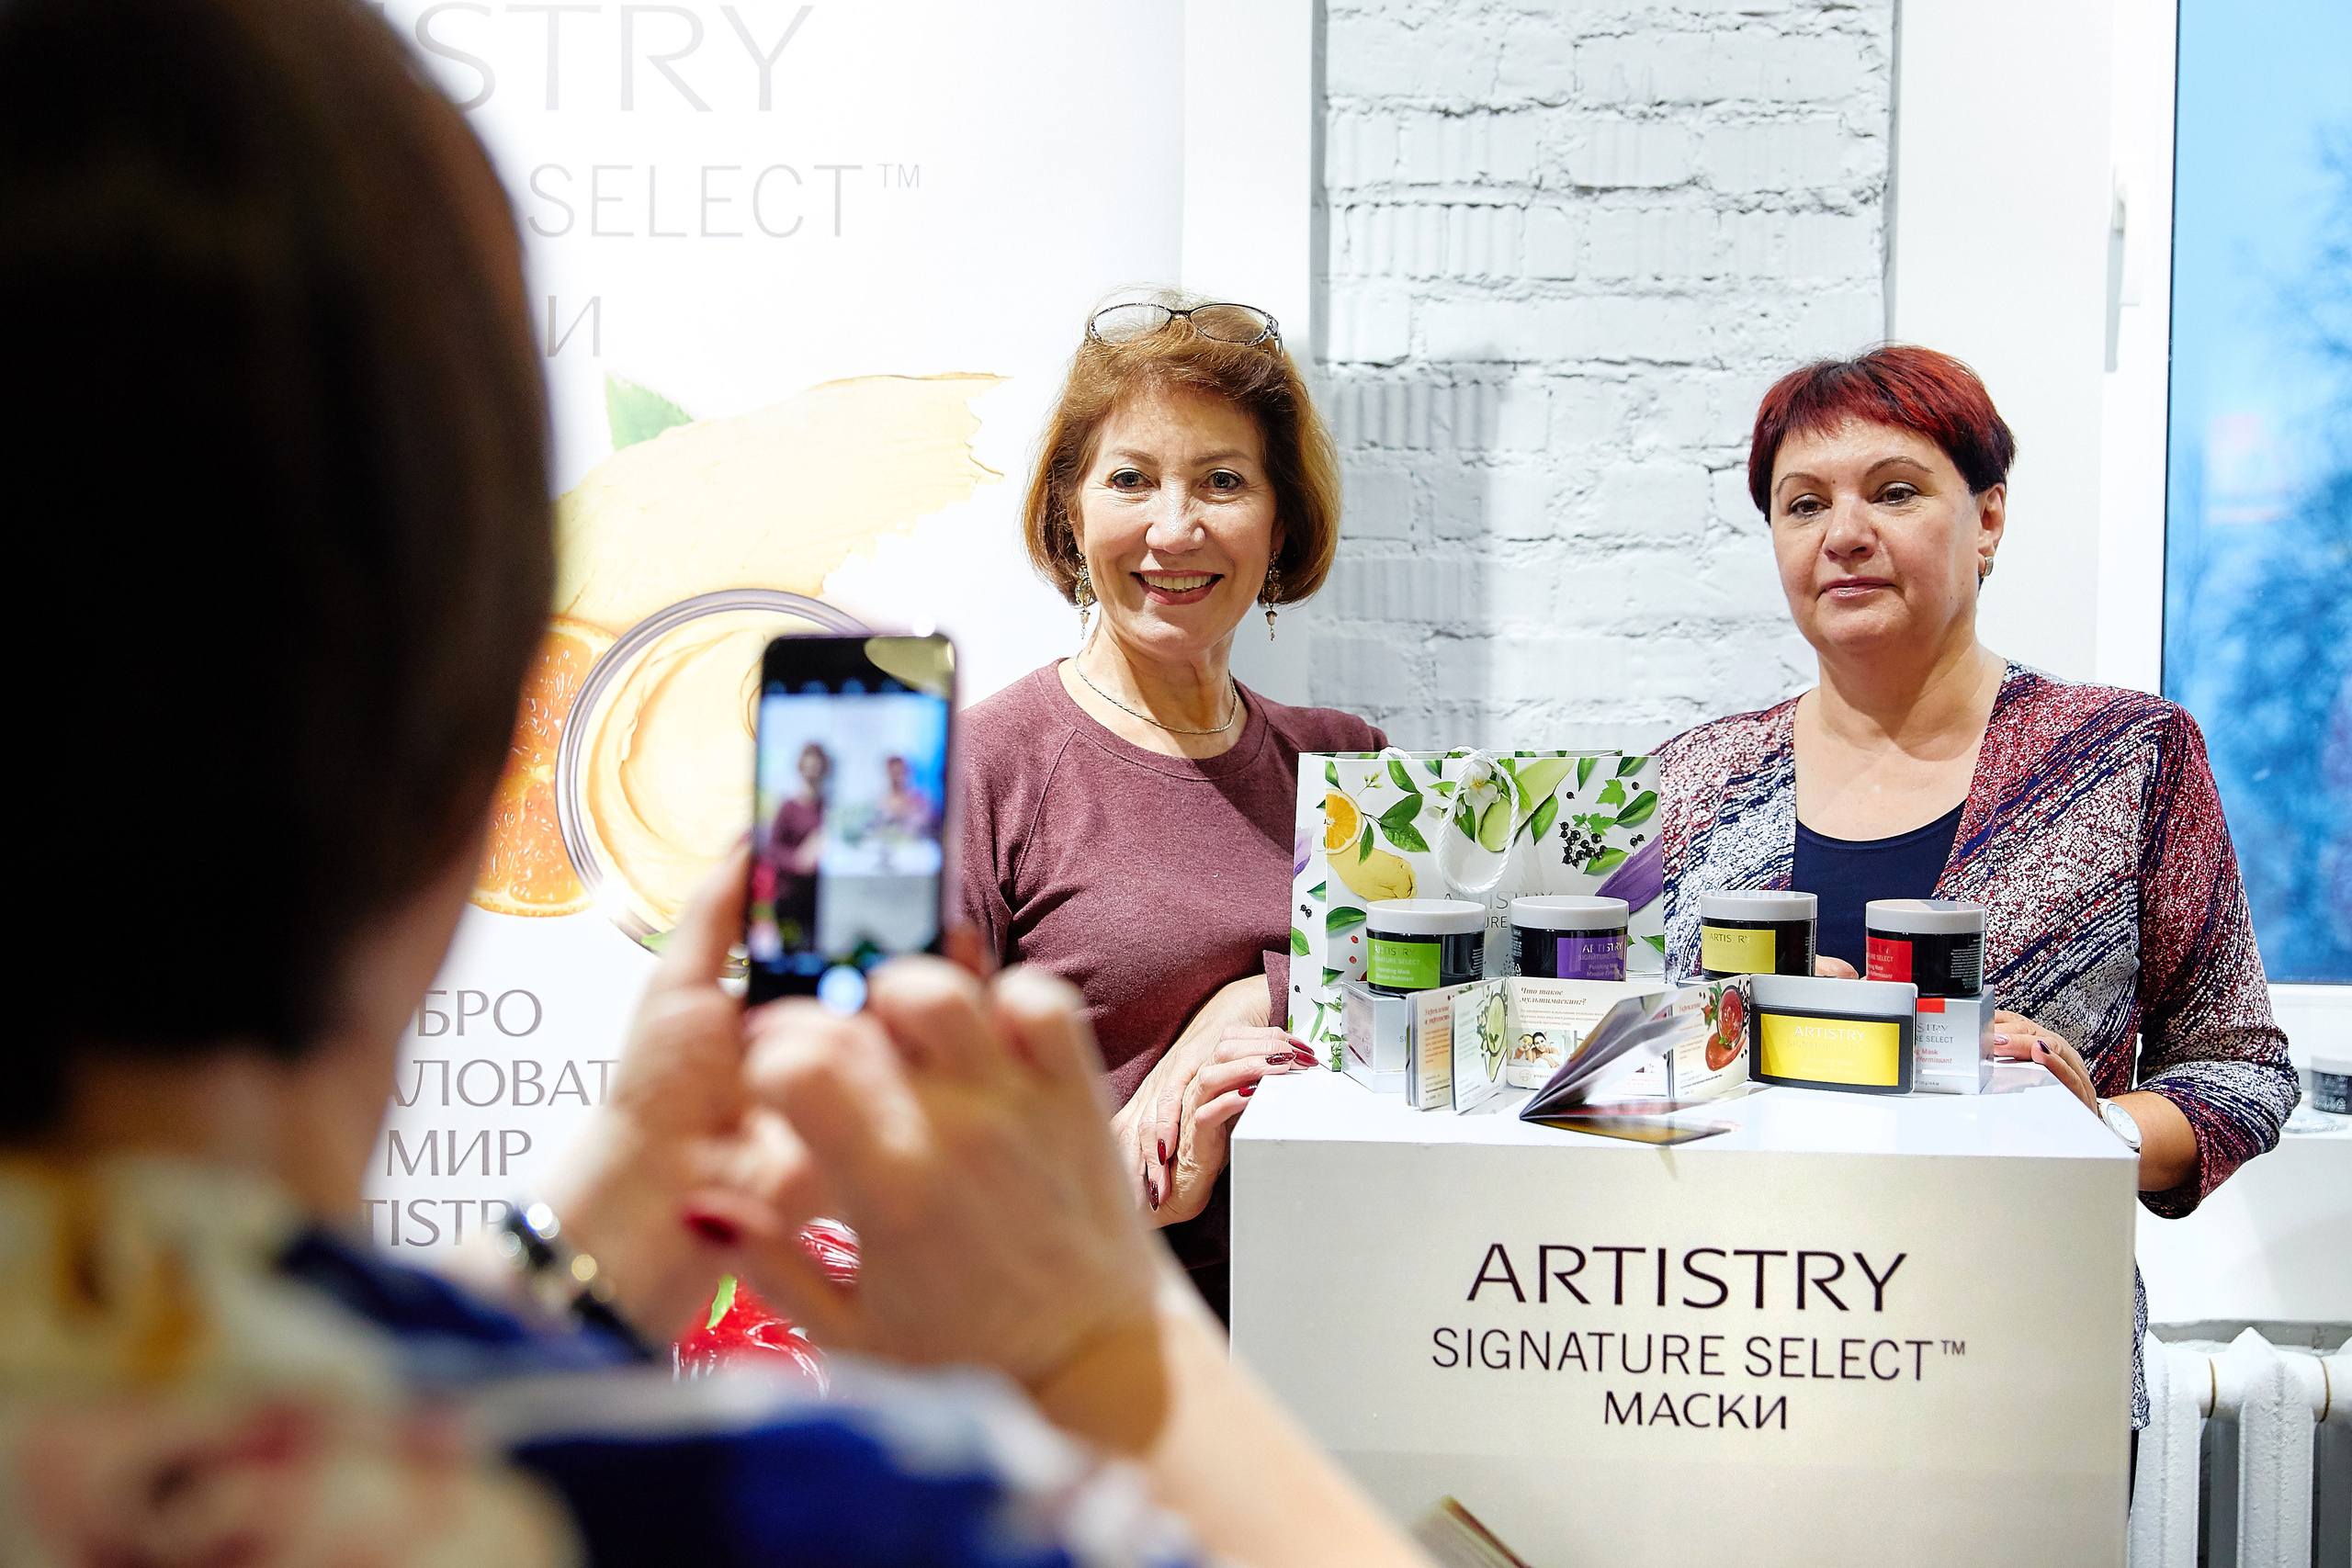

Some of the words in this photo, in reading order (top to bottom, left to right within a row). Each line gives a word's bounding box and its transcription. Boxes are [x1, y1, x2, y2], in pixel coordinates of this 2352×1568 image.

[415, 3, 815, 112] STRY
[1374, 944, 1415, 956] ARTISRY
[1709, 932, 1751, 943] ARTISRY
[1397, 958, 1420, 966] SELECT
[1520, 997, 1587, 1006] мультимаскинг?
[1521, 987, 1538, 995] Что
[417, 989, 543, 1037] БРО
[1917, 1022, 1950, 1033] STRY
[1794, 1026, 1865, 1042] ARTISTRY
[395, 1059, 621, 1107] ЛОВАТ
[387, 1130, 532, 1176] МИР
[361, 1199, 514, 1247] TISTR
[1466, 1244, 1907, 1312] ARTISTRY
[1431, 1327, 1724, 1376] SIGNATURE
[1604, 1391, 1787, 1429] МАСКИ
